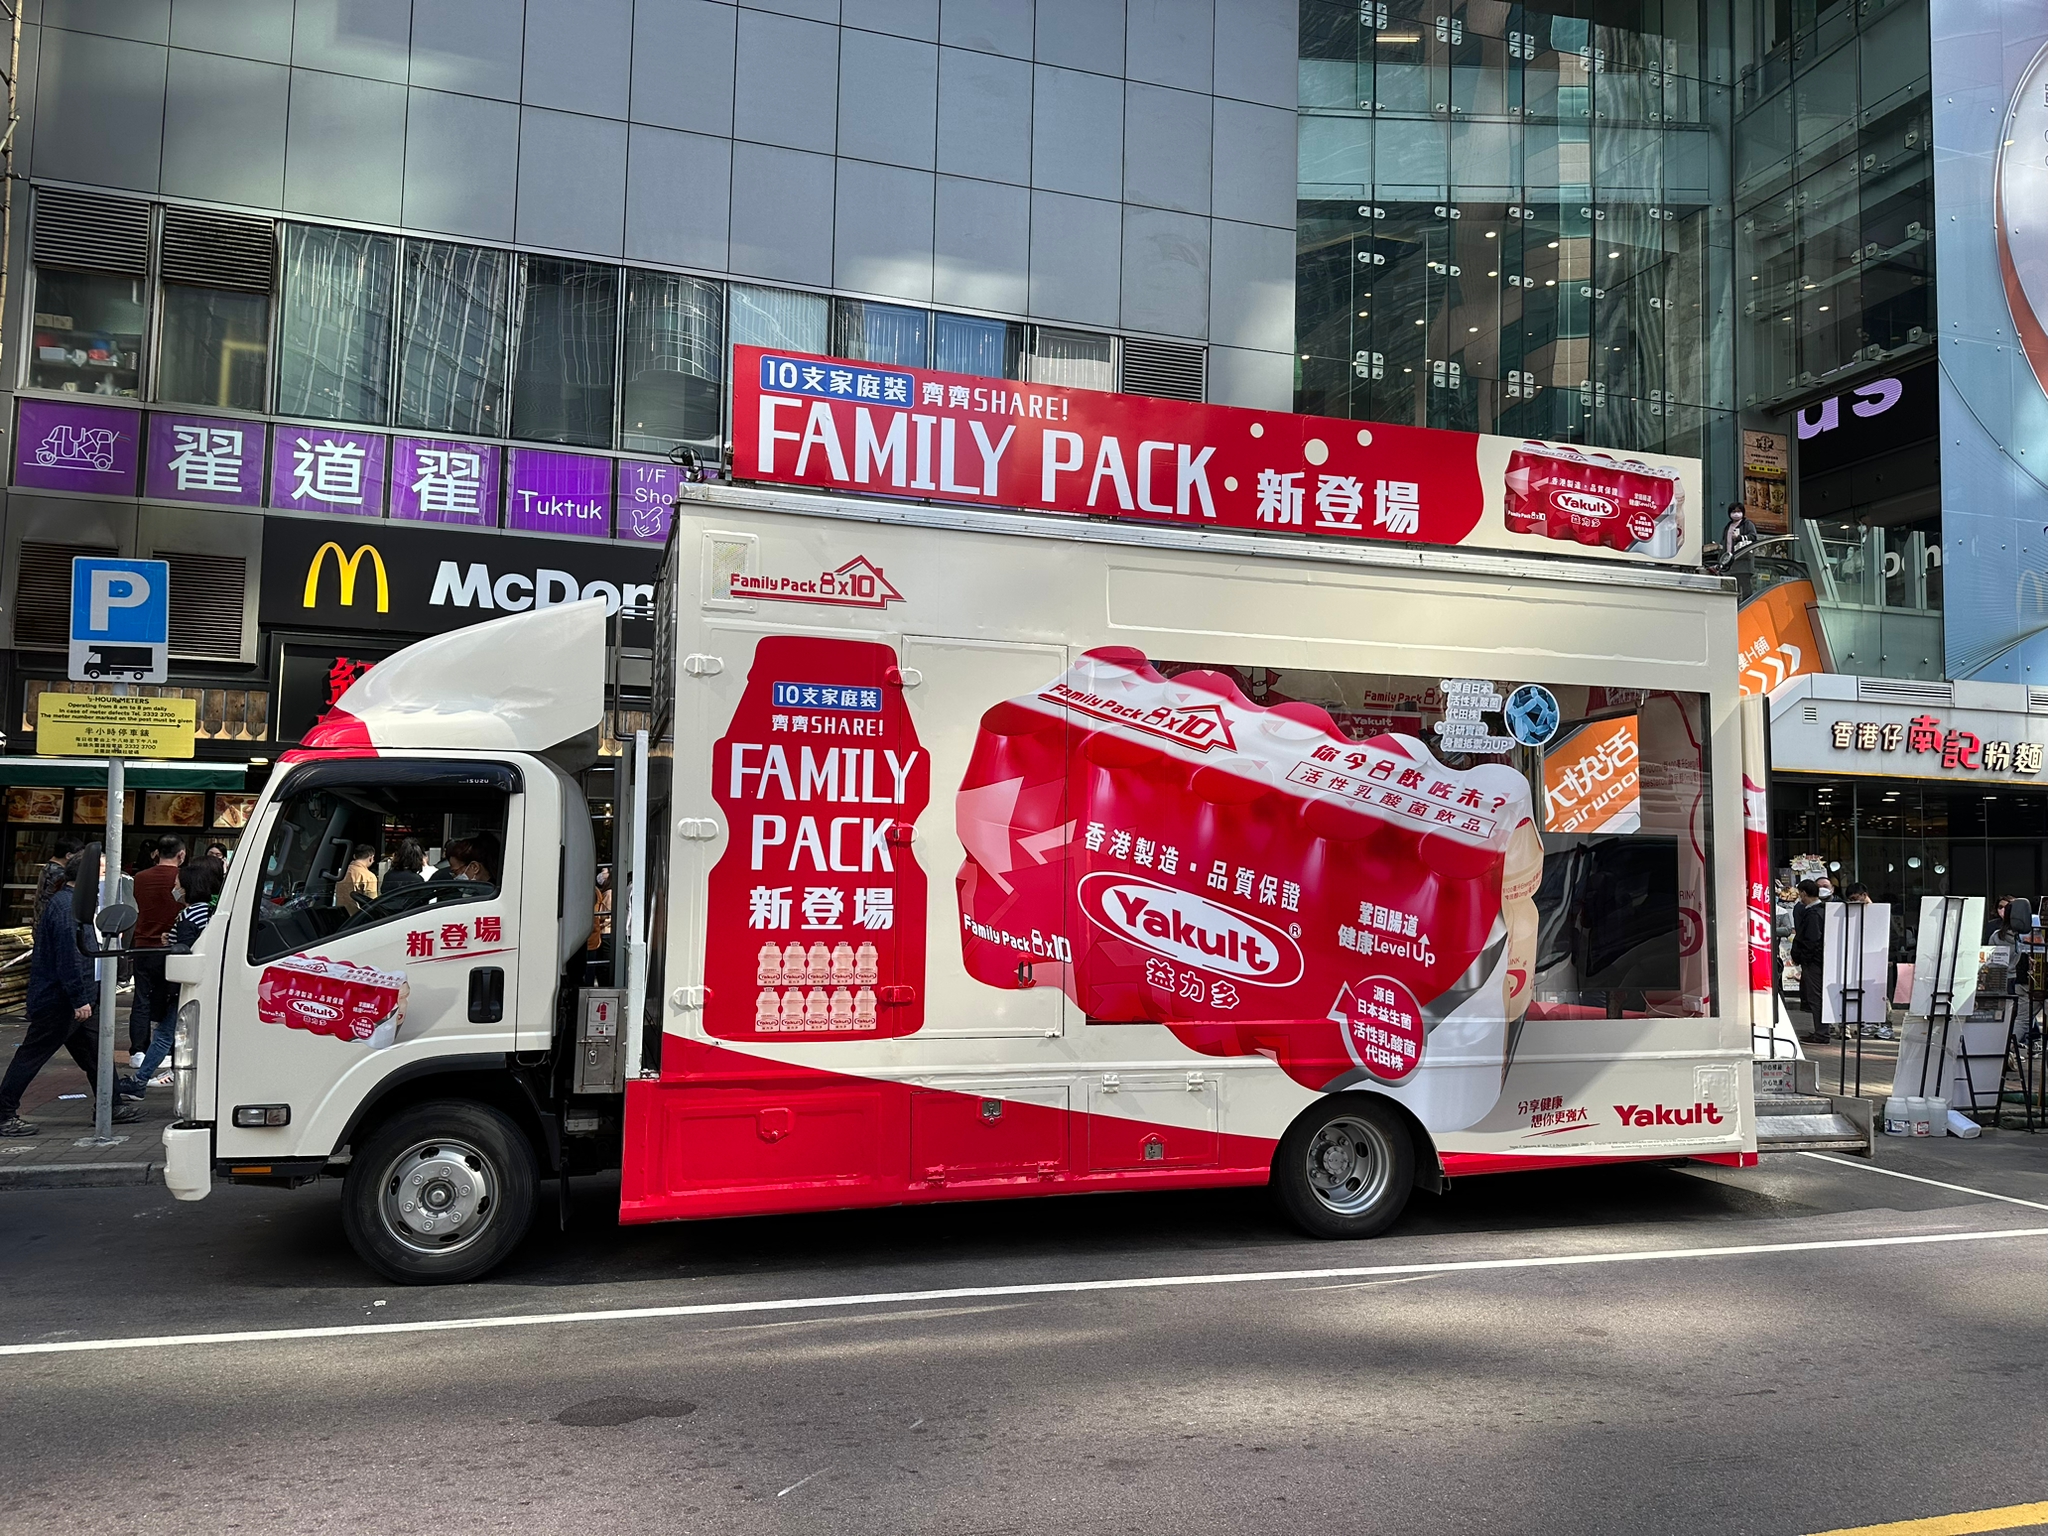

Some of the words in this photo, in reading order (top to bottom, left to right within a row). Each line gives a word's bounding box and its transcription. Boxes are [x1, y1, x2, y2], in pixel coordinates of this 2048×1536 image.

[765, 359, 908, 403] 10支家庭裝
[636, 467, 667, 484] 1/F
[758, 394, 1016, 497] FAMILY
[1041, 429, 1217, 518] PACK
[1256, 468, 1420, 535] 新登場
[516, 489, 602, 520] Tuktuk
[634, 487, 678, 506] Sho
[1562, 495, 1610, 515] Yakult
[730, 573, 778, 591] Family
[781, 577, 816, 593] Pack
[89, 569, 150, 631] P
[777, 684, 877, 709] 10支家庭裝
[1049, 683, 1104, 707] Family
[1100, 700, 1144, 720] Pack
[1364, 690, 1397, 702] Family
[1398, 692, 1422, 704] Pack
[1352, 716, 1394, 727] Yakult
[729, 743, 918, 805] FAMILY
[1300, 768, 1482, 832] 活性乳酸菌飲品
[751, 814, 895, 873] PACK
[748, 886, 893, 930] 新登場
[406, 916, 501, 957] 新登場
[963, 913, 1001, 945] Family
[1002, 930, 1031, 952] Pack
[1112, 890, 1272, 973] Yakult
[1145, 957, 1240, 1010] 益力多
[1373, 985, 1395, 1006] 源自
[294, 1001, 335, 1018] Yakult
[1357, 999, 1412, 1031] 日本益生菌
[1365, 1044, 1404, 1072] 代田株
[1517, 1095, 1564, 1116] 分享健康
[1531, 1107, 1588, 1129] 想你更強大
[1613, 1102, 1724, 1128] Yakult
